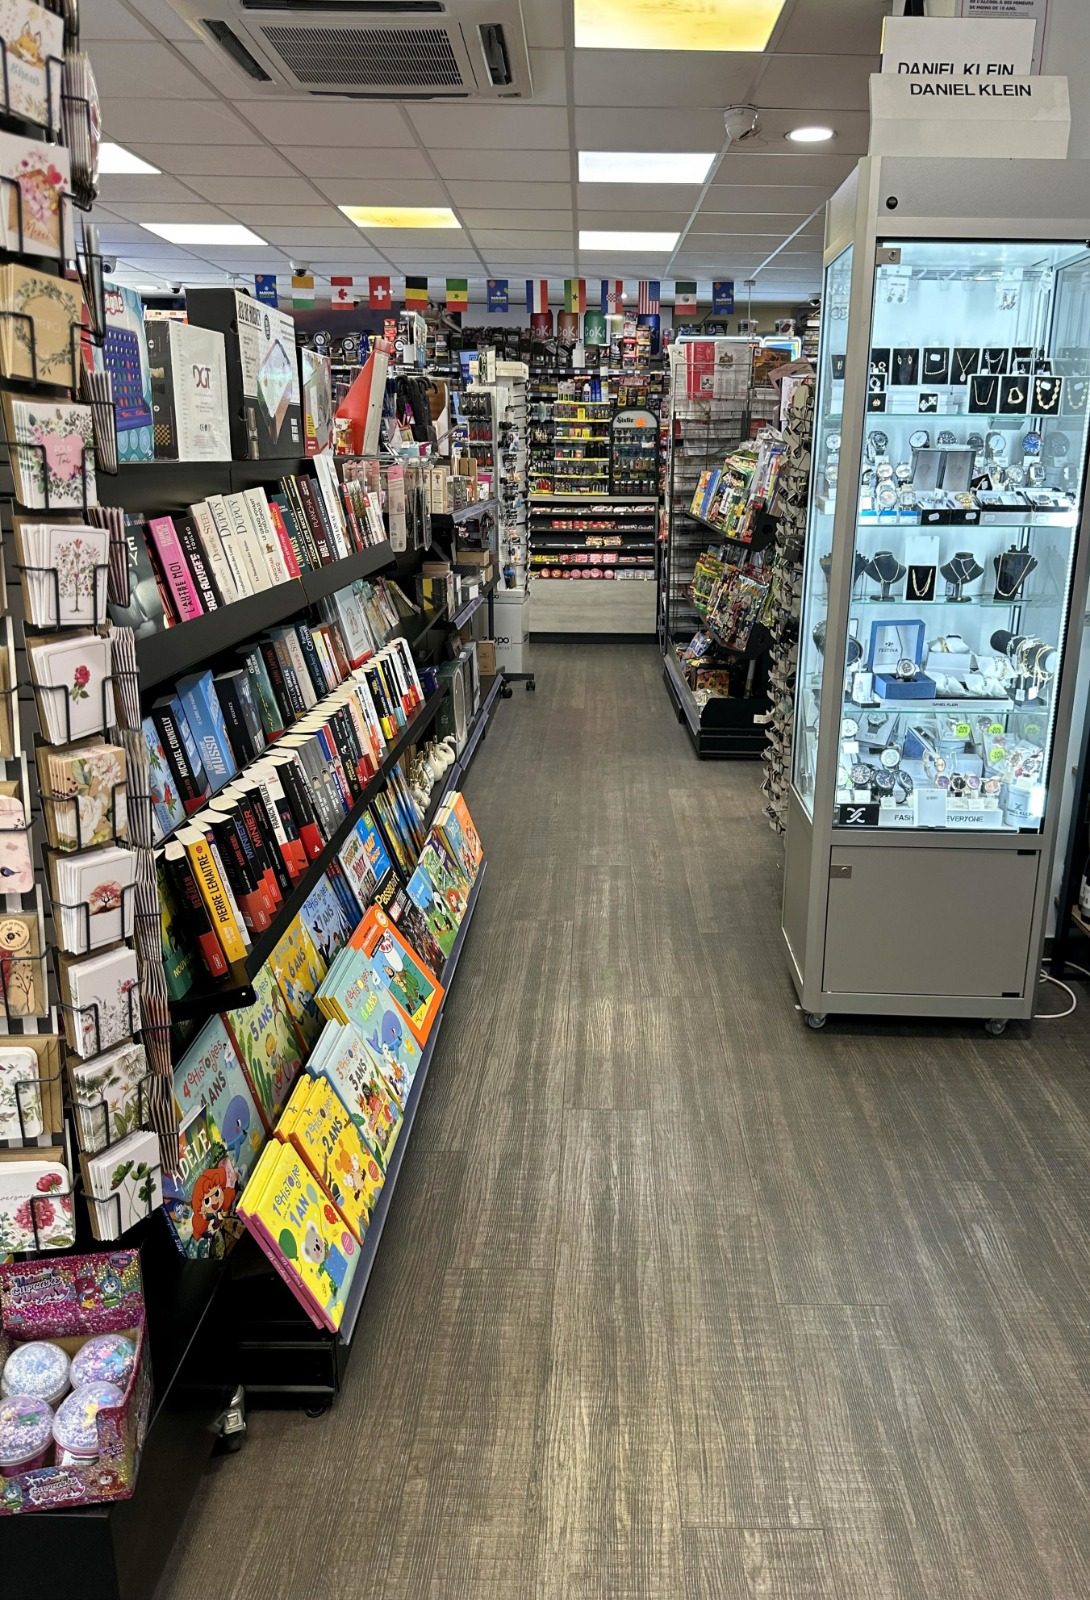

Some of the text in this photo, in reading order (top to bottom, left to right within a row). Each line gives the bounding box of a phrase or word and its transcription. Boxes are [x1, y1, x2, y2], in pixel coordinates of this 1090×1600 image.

[898, 62, 1014, 76] DANIEL KLEIN
[910, 83, 1032, 96] DANIEL KLEIN
[200, 512, 210, 534] STEEL
[213, 502, 231, 538] DUPUY
[230, 500, 247, 535] DUPUY
[258, 519, 266, 537] GRAND
[307, 500, 319, 527] PLANCHA
[318, 540, 330, 557] BIBLE
[190, 553, 210, 590] ROUGES
[169, 562, 195, 614] L'AUTRE MOI
[302, 624, 313, 651] Cornwell
[161, 717, 189, 777] MICHAEL CONNELLY
[204, 736, 226, 775] MUSSO
[260, 783, 272, 808] THILLIEZ
[244, 810, 262, 848] MINIER
[266, 808, 280, 830] FRANCK
[236, 820, 254, 860] MINIER
[198, 854, 219, 893] LEMAITRE
[212, 894, 230, 923] PIERRE
[322, 906, 334, 926] ANS
[288, 948, 306, 976] 6 ANS
[365, 990, 378, 1014] ANS
[250, 1022, 262, 1042] 5
[256, 1002, 273, 1034] ANS
[349, 1054, 368, 1092] 3 ANS
[182, 1080, 192, 1100] 4
[207, 1070, 228, 1108] ANS
[305, 1130, 315, 1146] 2
[322, 1116, 345, 1155] 2 ANS
[289, 1194, 310, 1228] 1 AN
